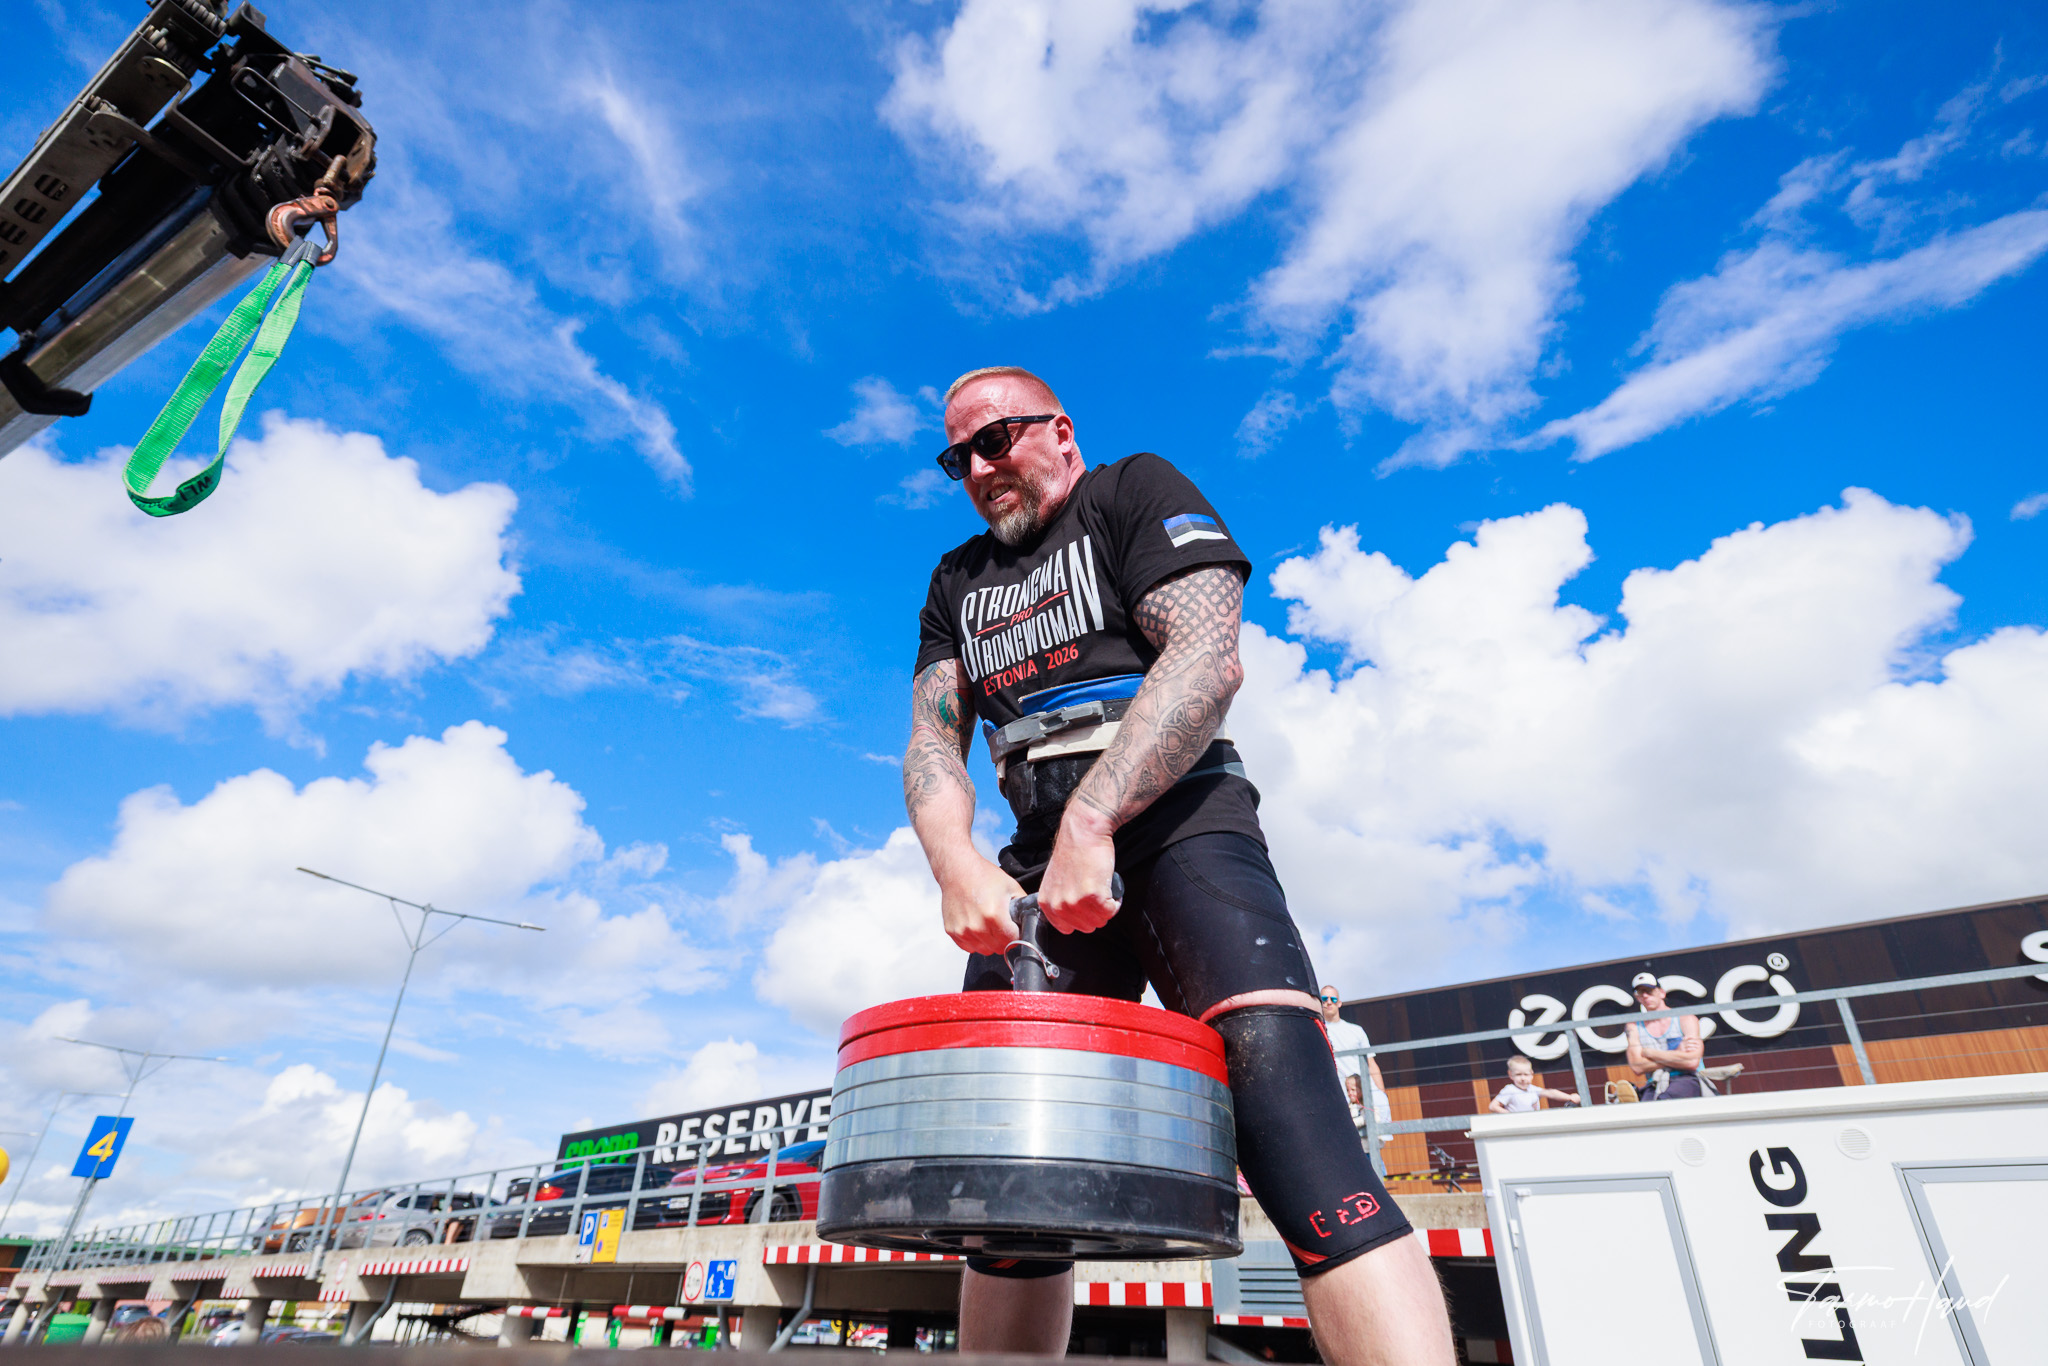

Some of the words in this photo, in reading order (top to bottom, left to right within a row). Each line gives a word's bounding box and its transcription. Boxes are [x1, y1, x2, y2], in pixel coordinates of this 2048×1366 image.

[961, 535, 1104, 632] STRONGMAN
[961, 595, 1104, 683] STRONGWOMAN
[1010, 606, 1034, 627] PRO
[983, 659, 1039, 697] ESTONIA
[1044, 643, 1079, 670] 2026
[87, 1131, 118, 1162] 4
[582, 1216, 595, 1244] P
[1749, 1146, 1866, 1366] LING
